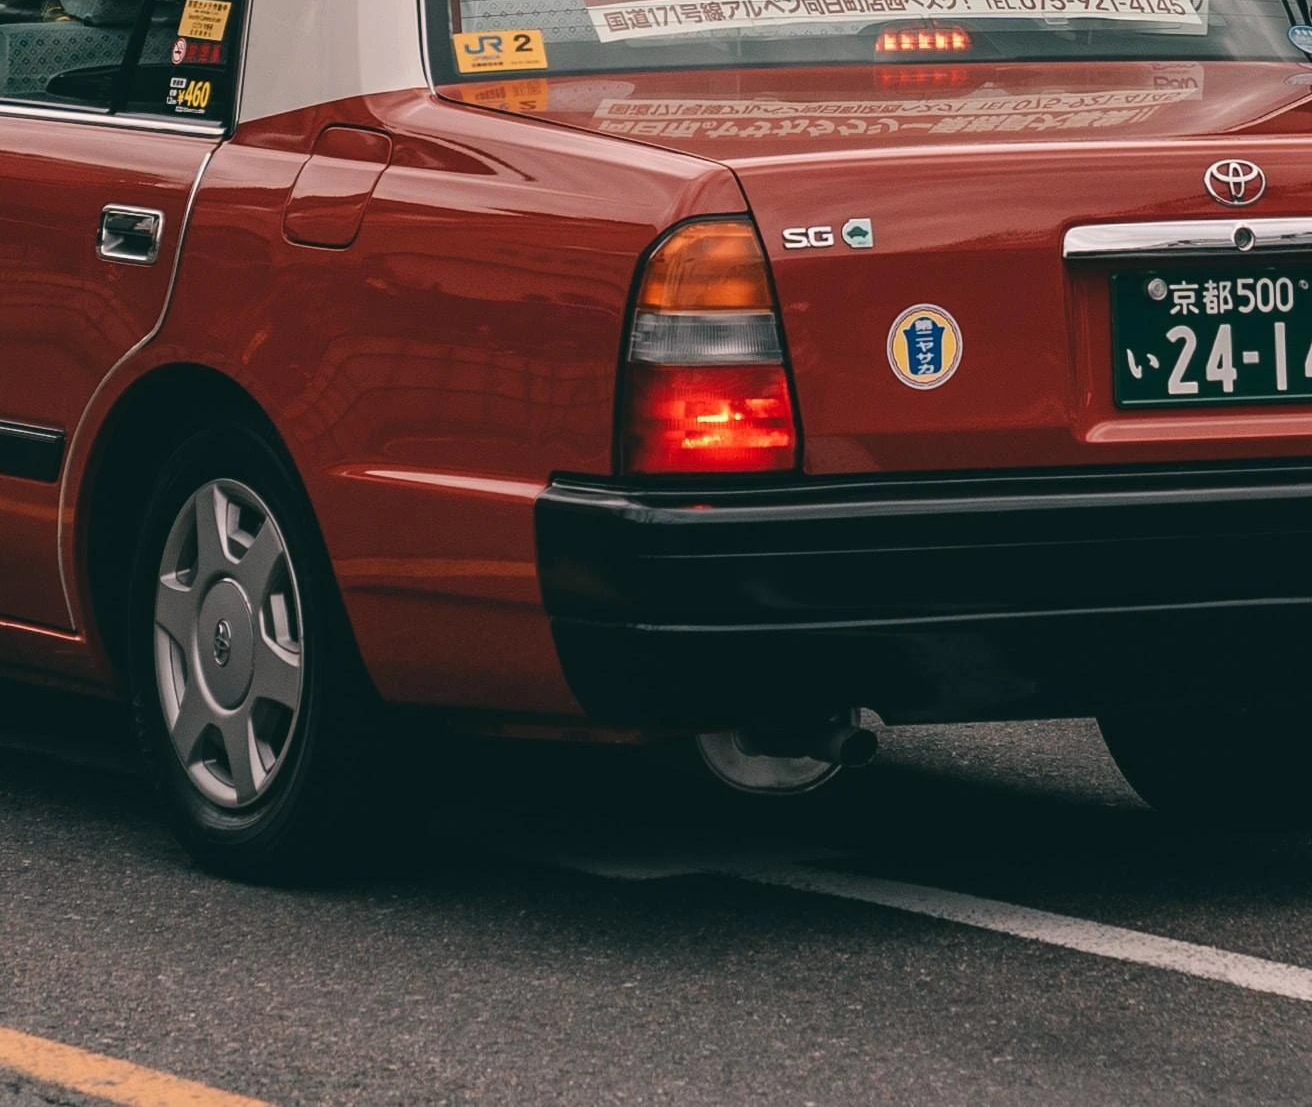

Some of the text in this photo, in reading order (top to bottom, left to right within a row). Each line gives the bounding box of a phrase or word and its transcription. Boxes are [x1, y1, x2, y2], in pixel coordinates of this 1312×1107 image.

[464, 34, 533, 54] JR 2
[177, 80, 210, 108] ¥460
[1126, 348, 1160, 379] い
